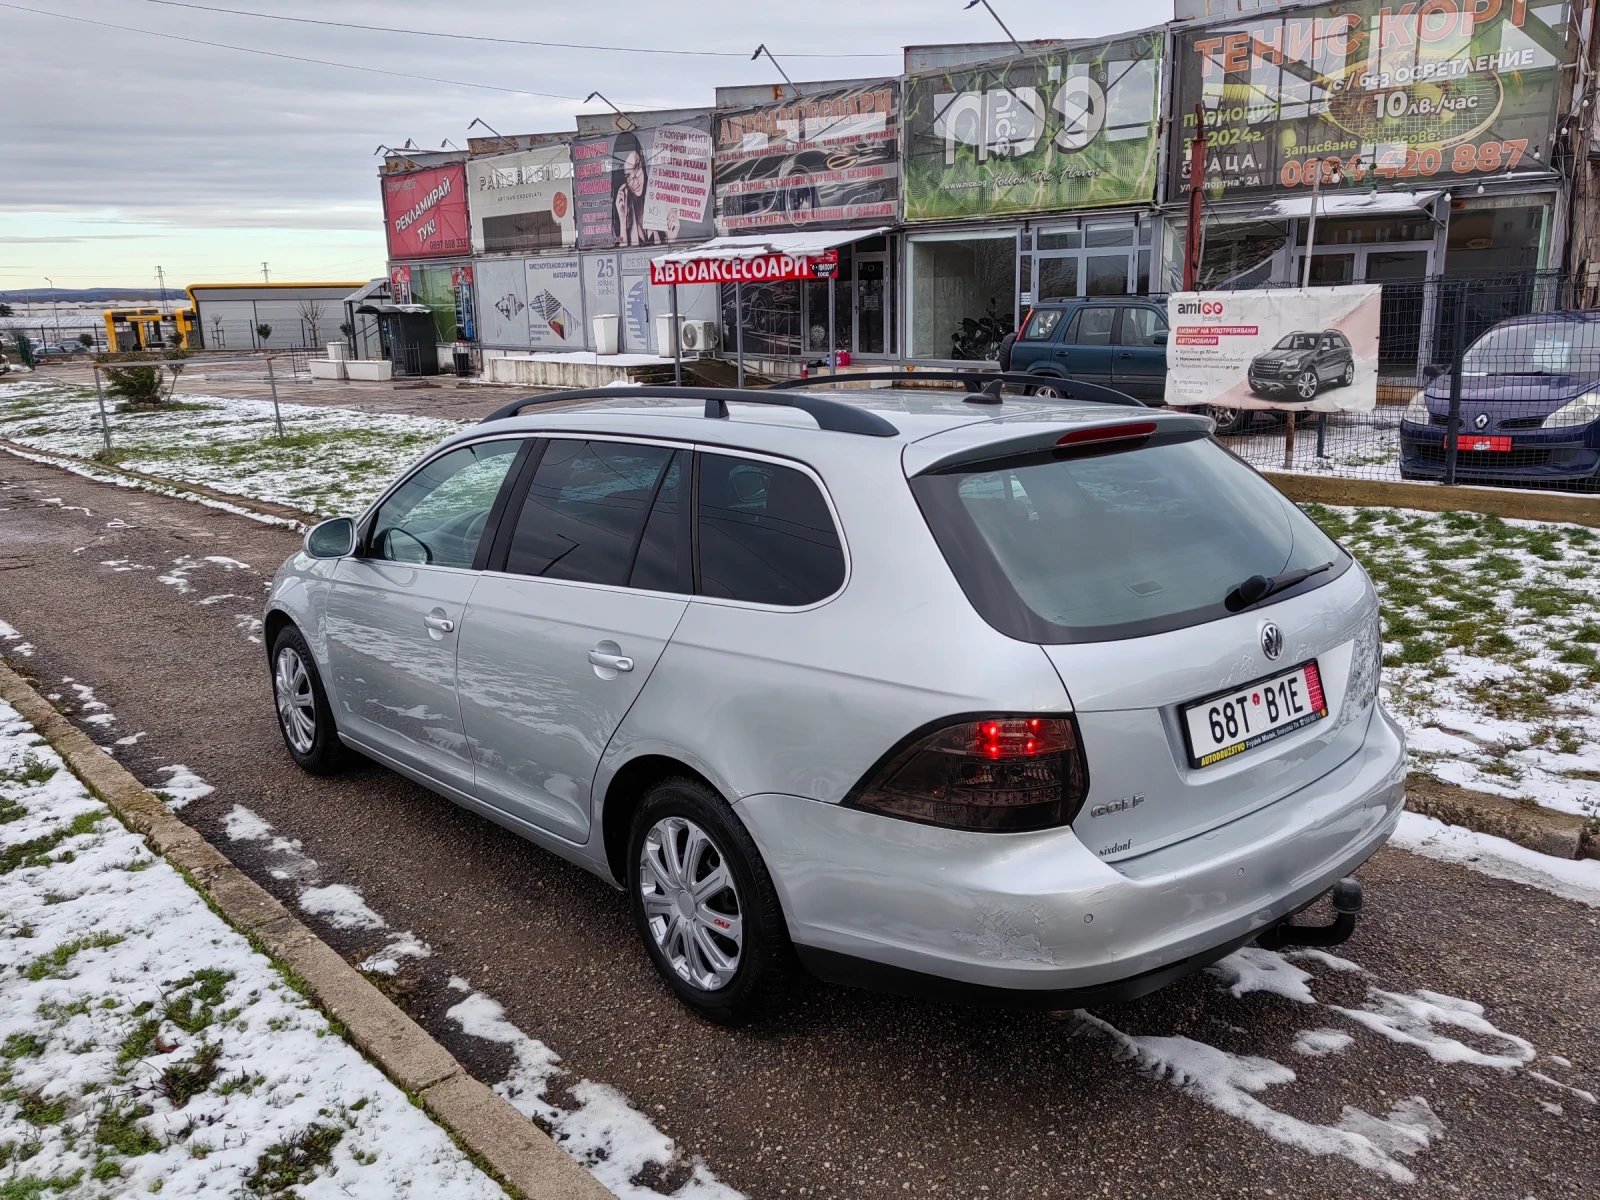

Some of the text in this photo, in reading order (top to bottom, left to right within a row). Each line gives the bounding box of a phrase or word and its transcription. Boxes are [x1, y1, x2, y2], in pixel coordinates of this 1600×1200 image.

[1194, 14, 1362, 77] ТЕНИС
[1359, 69, 1390, 88] без
[1395, 48, 1534, 82] ОСВЕТЛЕНИЕ
[719, 88, 892, 144] АВТОАКСЕСОАРИ
[1184, 103, 1279, 127] ПОМОЦИЯ
[1208, 127, 1265, 147] 2024г.
[1383, 130, 1441, 144] часове:
[683, 159, 708, 171] РЕКЛАМА
[1281, 138, 1529, 187] 0894 420 887
[479, 164, 561, 191] PANCRACIO
[681, 171, 705, 184] РЕКЛАМА
[944, 163, 1103, 191] www.nice.bg Follow the Flavor
[395, 176, 451, 233] РЕКЛАМИРАЙ
[417, 219, 436, 242] ТУК!
[597, 258, 614, 278] 25
[654, 255, 808, 283] АВТОАКСЕСОАРИ
[1178, 327, 1200, 335] ЛИЗИНГ
[1211, 326, 1257, 334] УПОТРЕБЯВАНИ
[1203, 315, 1222, 323] leasing
[1177, 337, 1217, 345] АВТОМОБИЛИ
[1209, 696, 1250, 744] 68T
[1264, 677, 1304, 724] B1E
[1201, 742, 1246, 767] AUTODRUŽSTVO
[1091, 792, 1145, 819] GOLF
[713, 918, 731, 929] EVO
